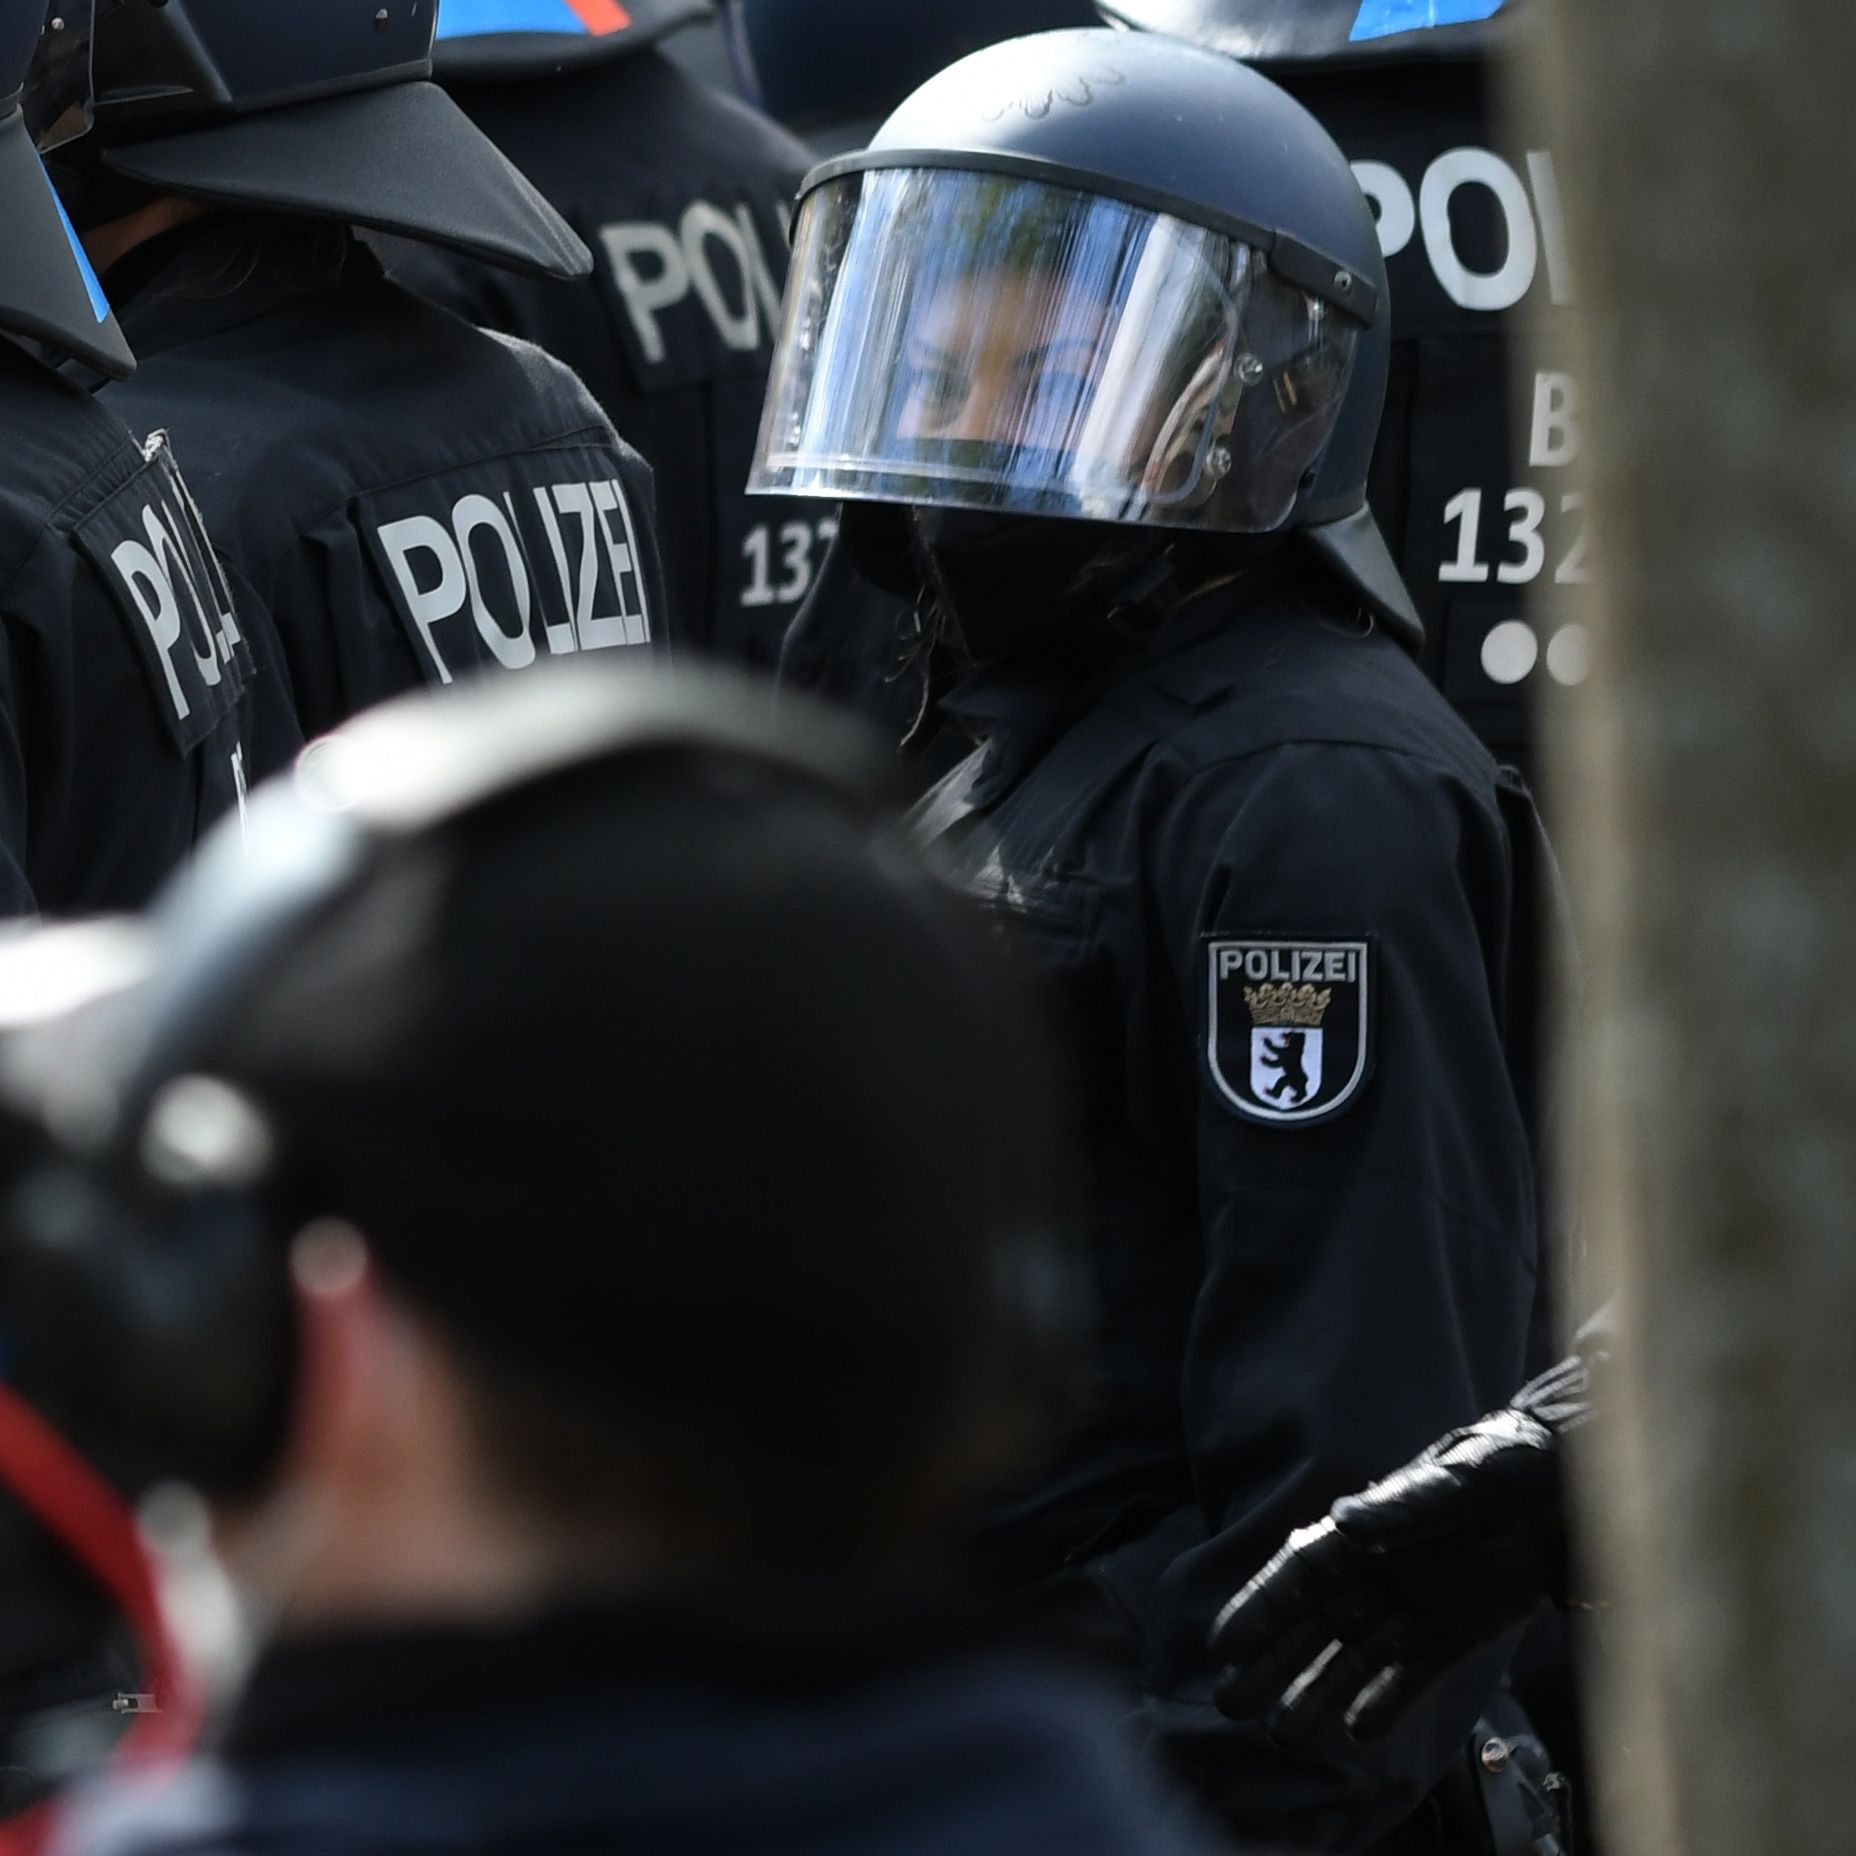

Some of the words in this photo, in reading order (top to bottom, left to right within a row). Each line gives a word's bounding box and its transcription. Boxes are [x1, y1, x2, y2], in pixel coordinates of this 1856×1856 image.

[1529, 372, 1581, 467] B
[377, 478, 652, 685] POLIZEI
[740, 517, 840, 606] 13
[1438, 486, 1588, 585] 132
[1219, 948, 1357, 983] POLIZEI
